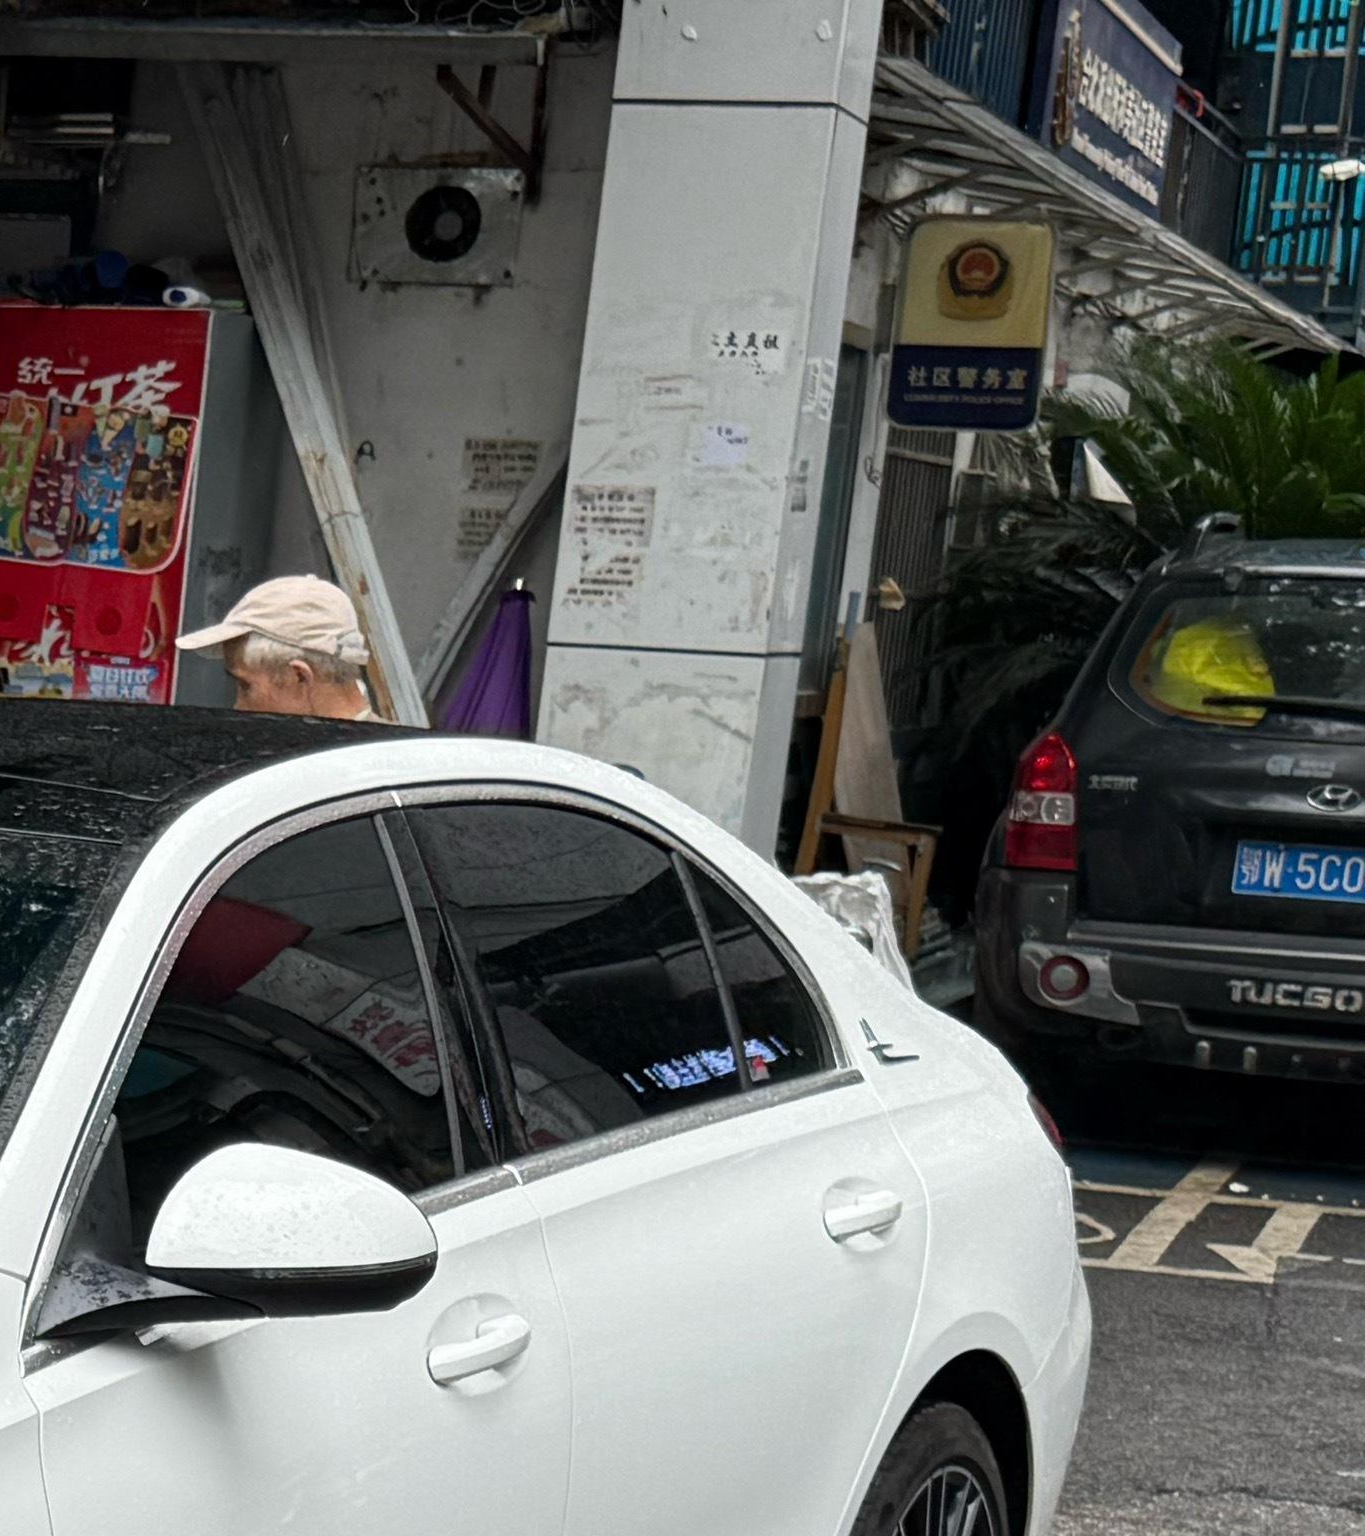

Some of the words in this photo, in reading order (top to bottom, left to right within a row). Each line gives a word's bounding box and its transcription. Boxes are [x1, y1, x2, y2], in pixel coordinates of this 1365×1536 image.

[18, 357, 85, 385] 统一
[907, 365, 1028, 390] 社区警务室
[47, 360, 182, 413] 红茶
